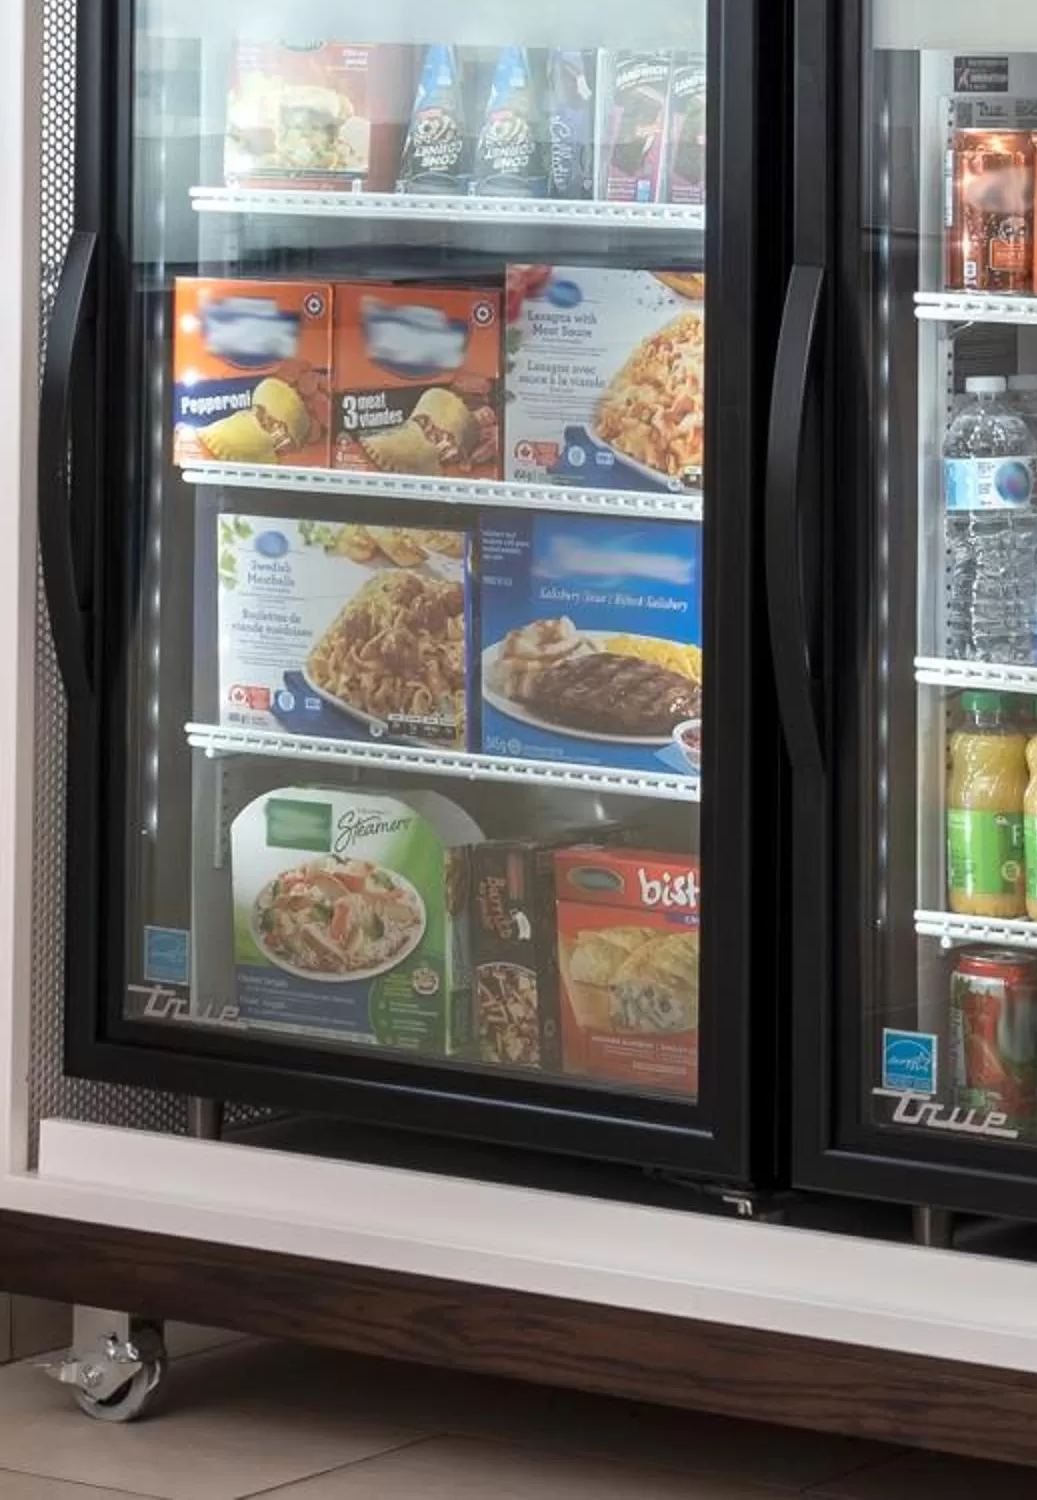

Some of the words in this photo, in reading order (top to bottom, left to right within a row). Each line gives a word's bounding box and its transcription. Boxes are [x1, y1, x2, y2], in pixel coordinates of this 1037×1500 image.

[181, 389, 251, 415] Pepperoni
[341, 395, 359, 430] 3
[358, 392, 387, 409] meat
